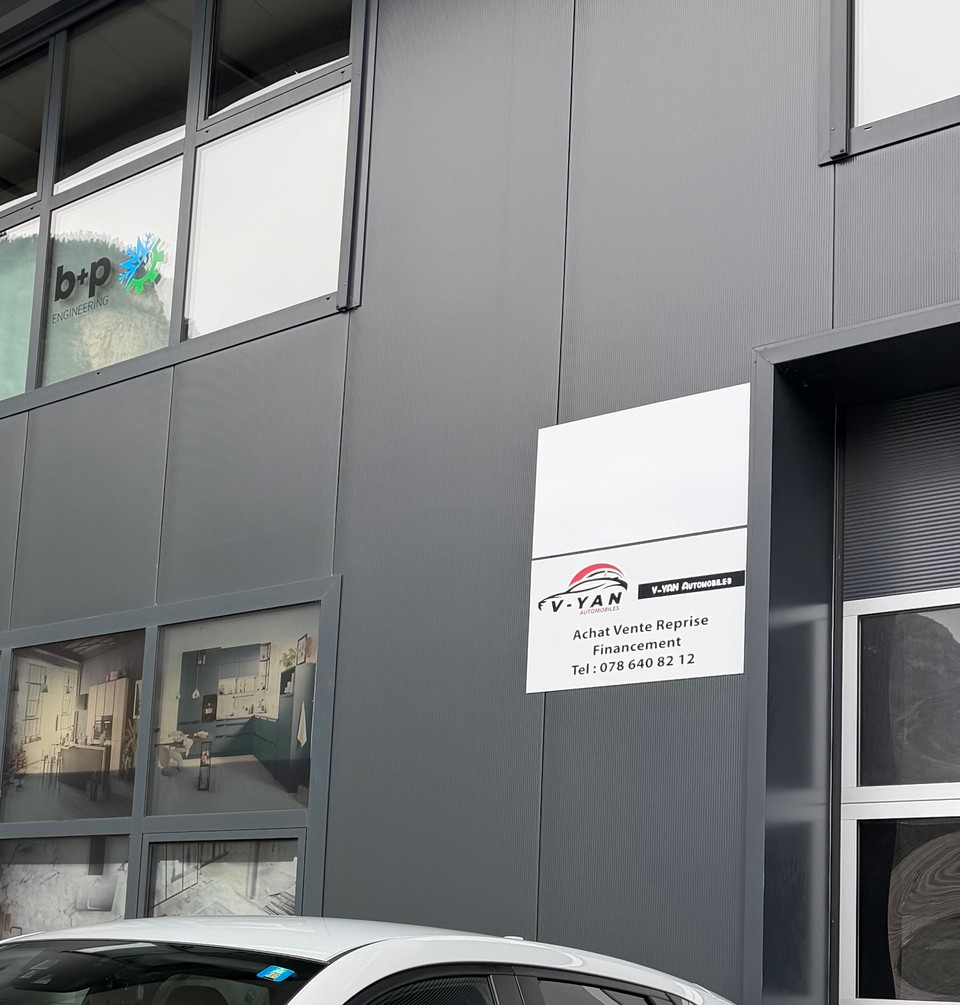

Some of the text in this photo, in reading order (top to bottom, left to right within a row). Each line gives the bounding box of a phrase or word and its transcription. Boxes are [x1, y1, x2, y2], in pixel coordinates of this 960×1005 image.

[54, 257, 112, 302] b+p
[51, 295, 109, 325] ENGINEERING
[651, 582, 680, 594] V-YAN
[551, 591, 622, 613] V-YAN
[578, 605, 620, 615] AUTOMOBILES
[572, 615, 709, 640] Achat Vente Reprise
[592, 636, 682, 656] Financement
[599, 660, 625, 673] 078
[628, 657, 654, 670] 640
[656, 655, 674, 667] 82
[678, 653, 695, 665] 12
